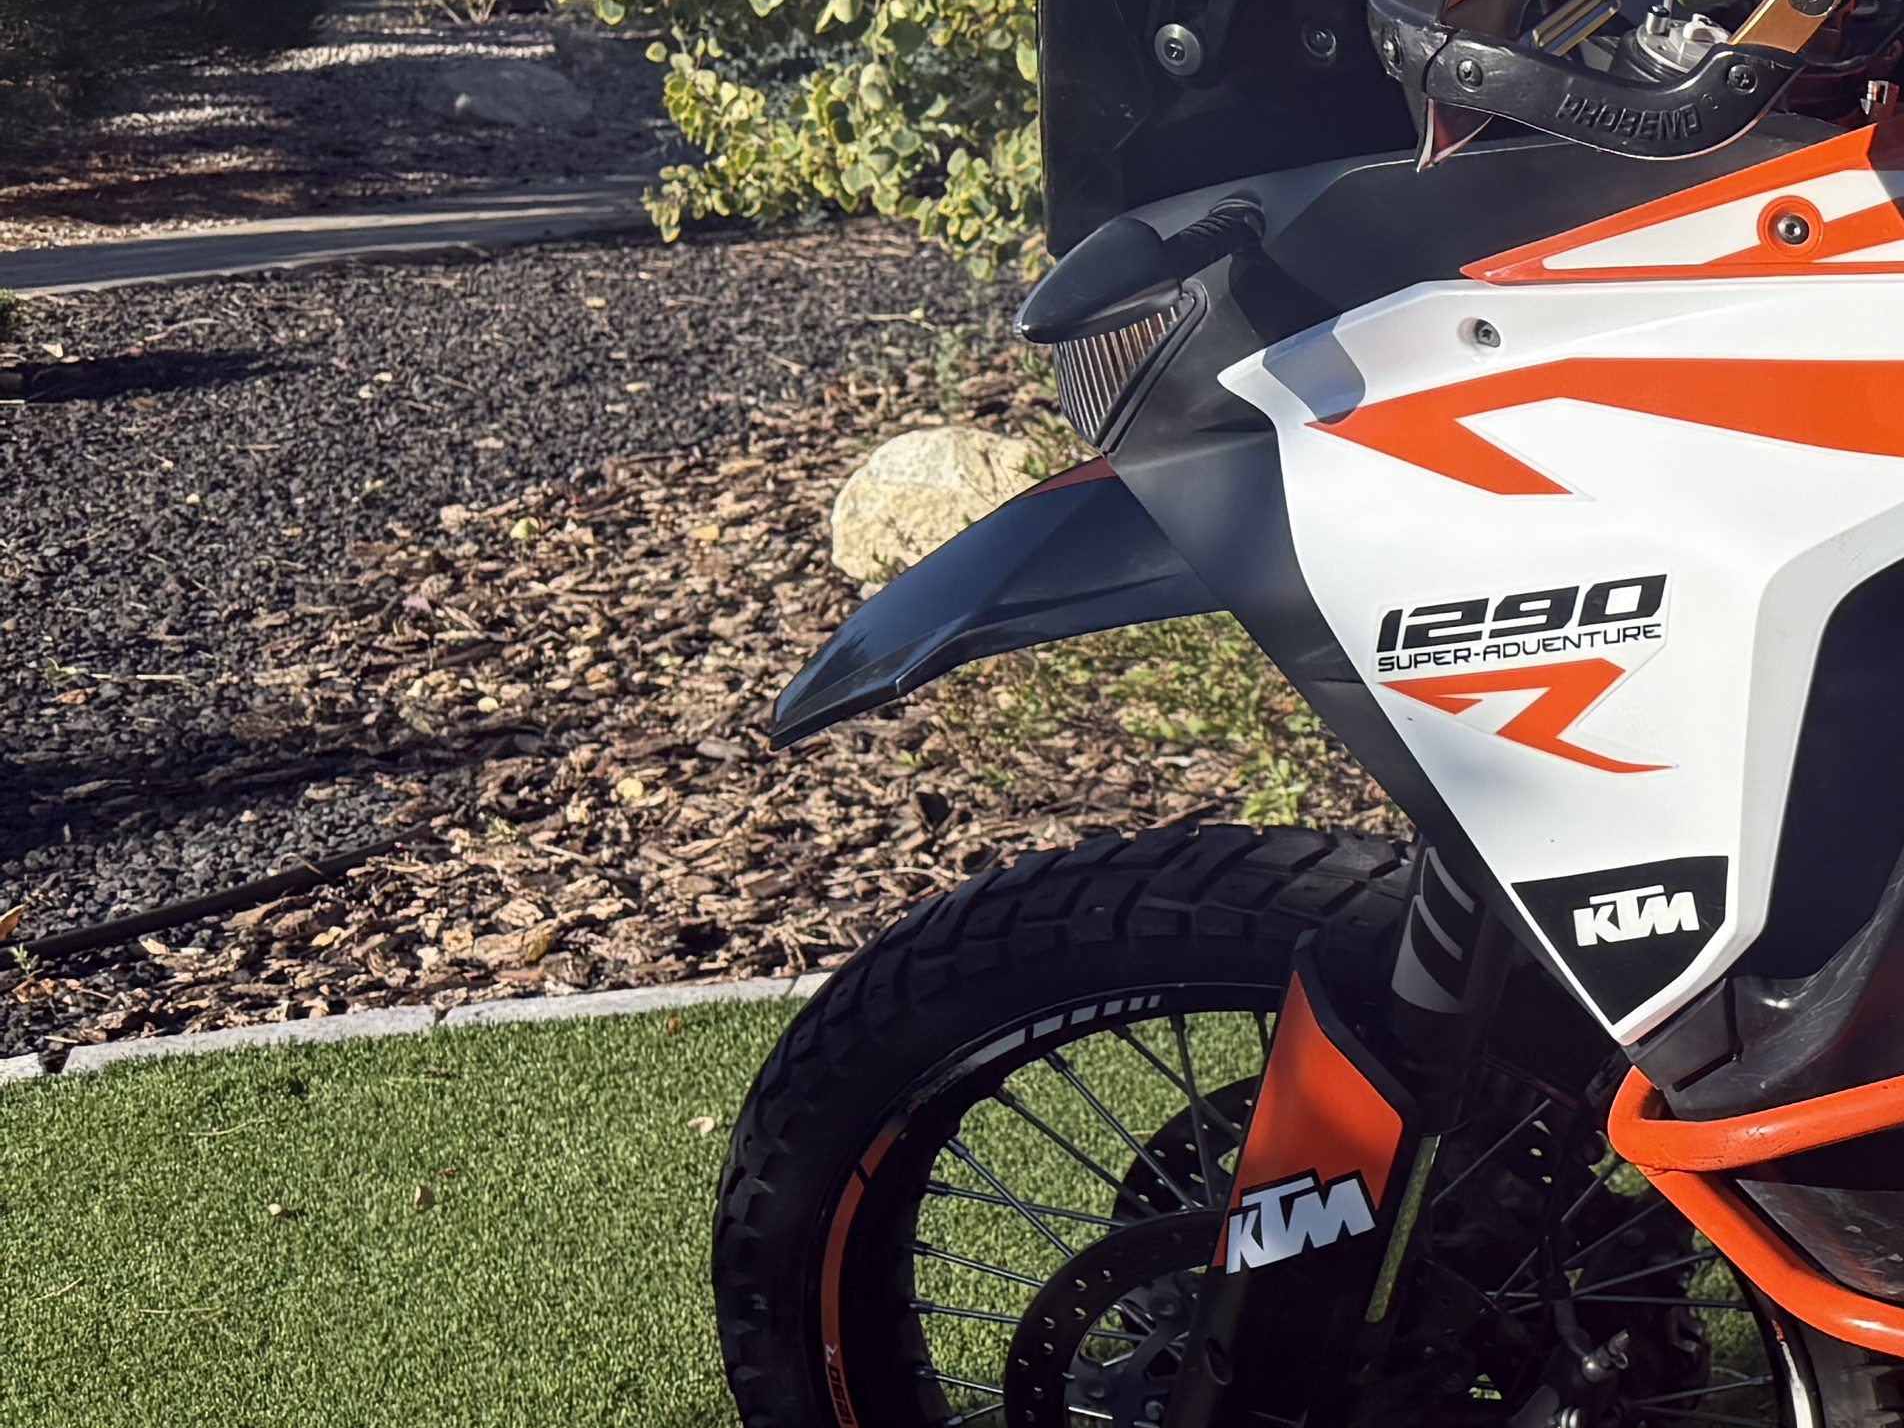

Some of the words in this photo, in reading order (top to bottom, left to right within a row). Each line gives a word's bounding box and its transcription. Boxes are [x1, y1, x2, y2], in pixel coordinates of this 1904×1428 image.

[1376, 574, 1667, 653] 1290
[1378, 624, 1662, 672] SUPER-ADVENTURE
[1573, 884, 1700, 947] KTM
[1226, 1176, 1376, 1275] KTM
